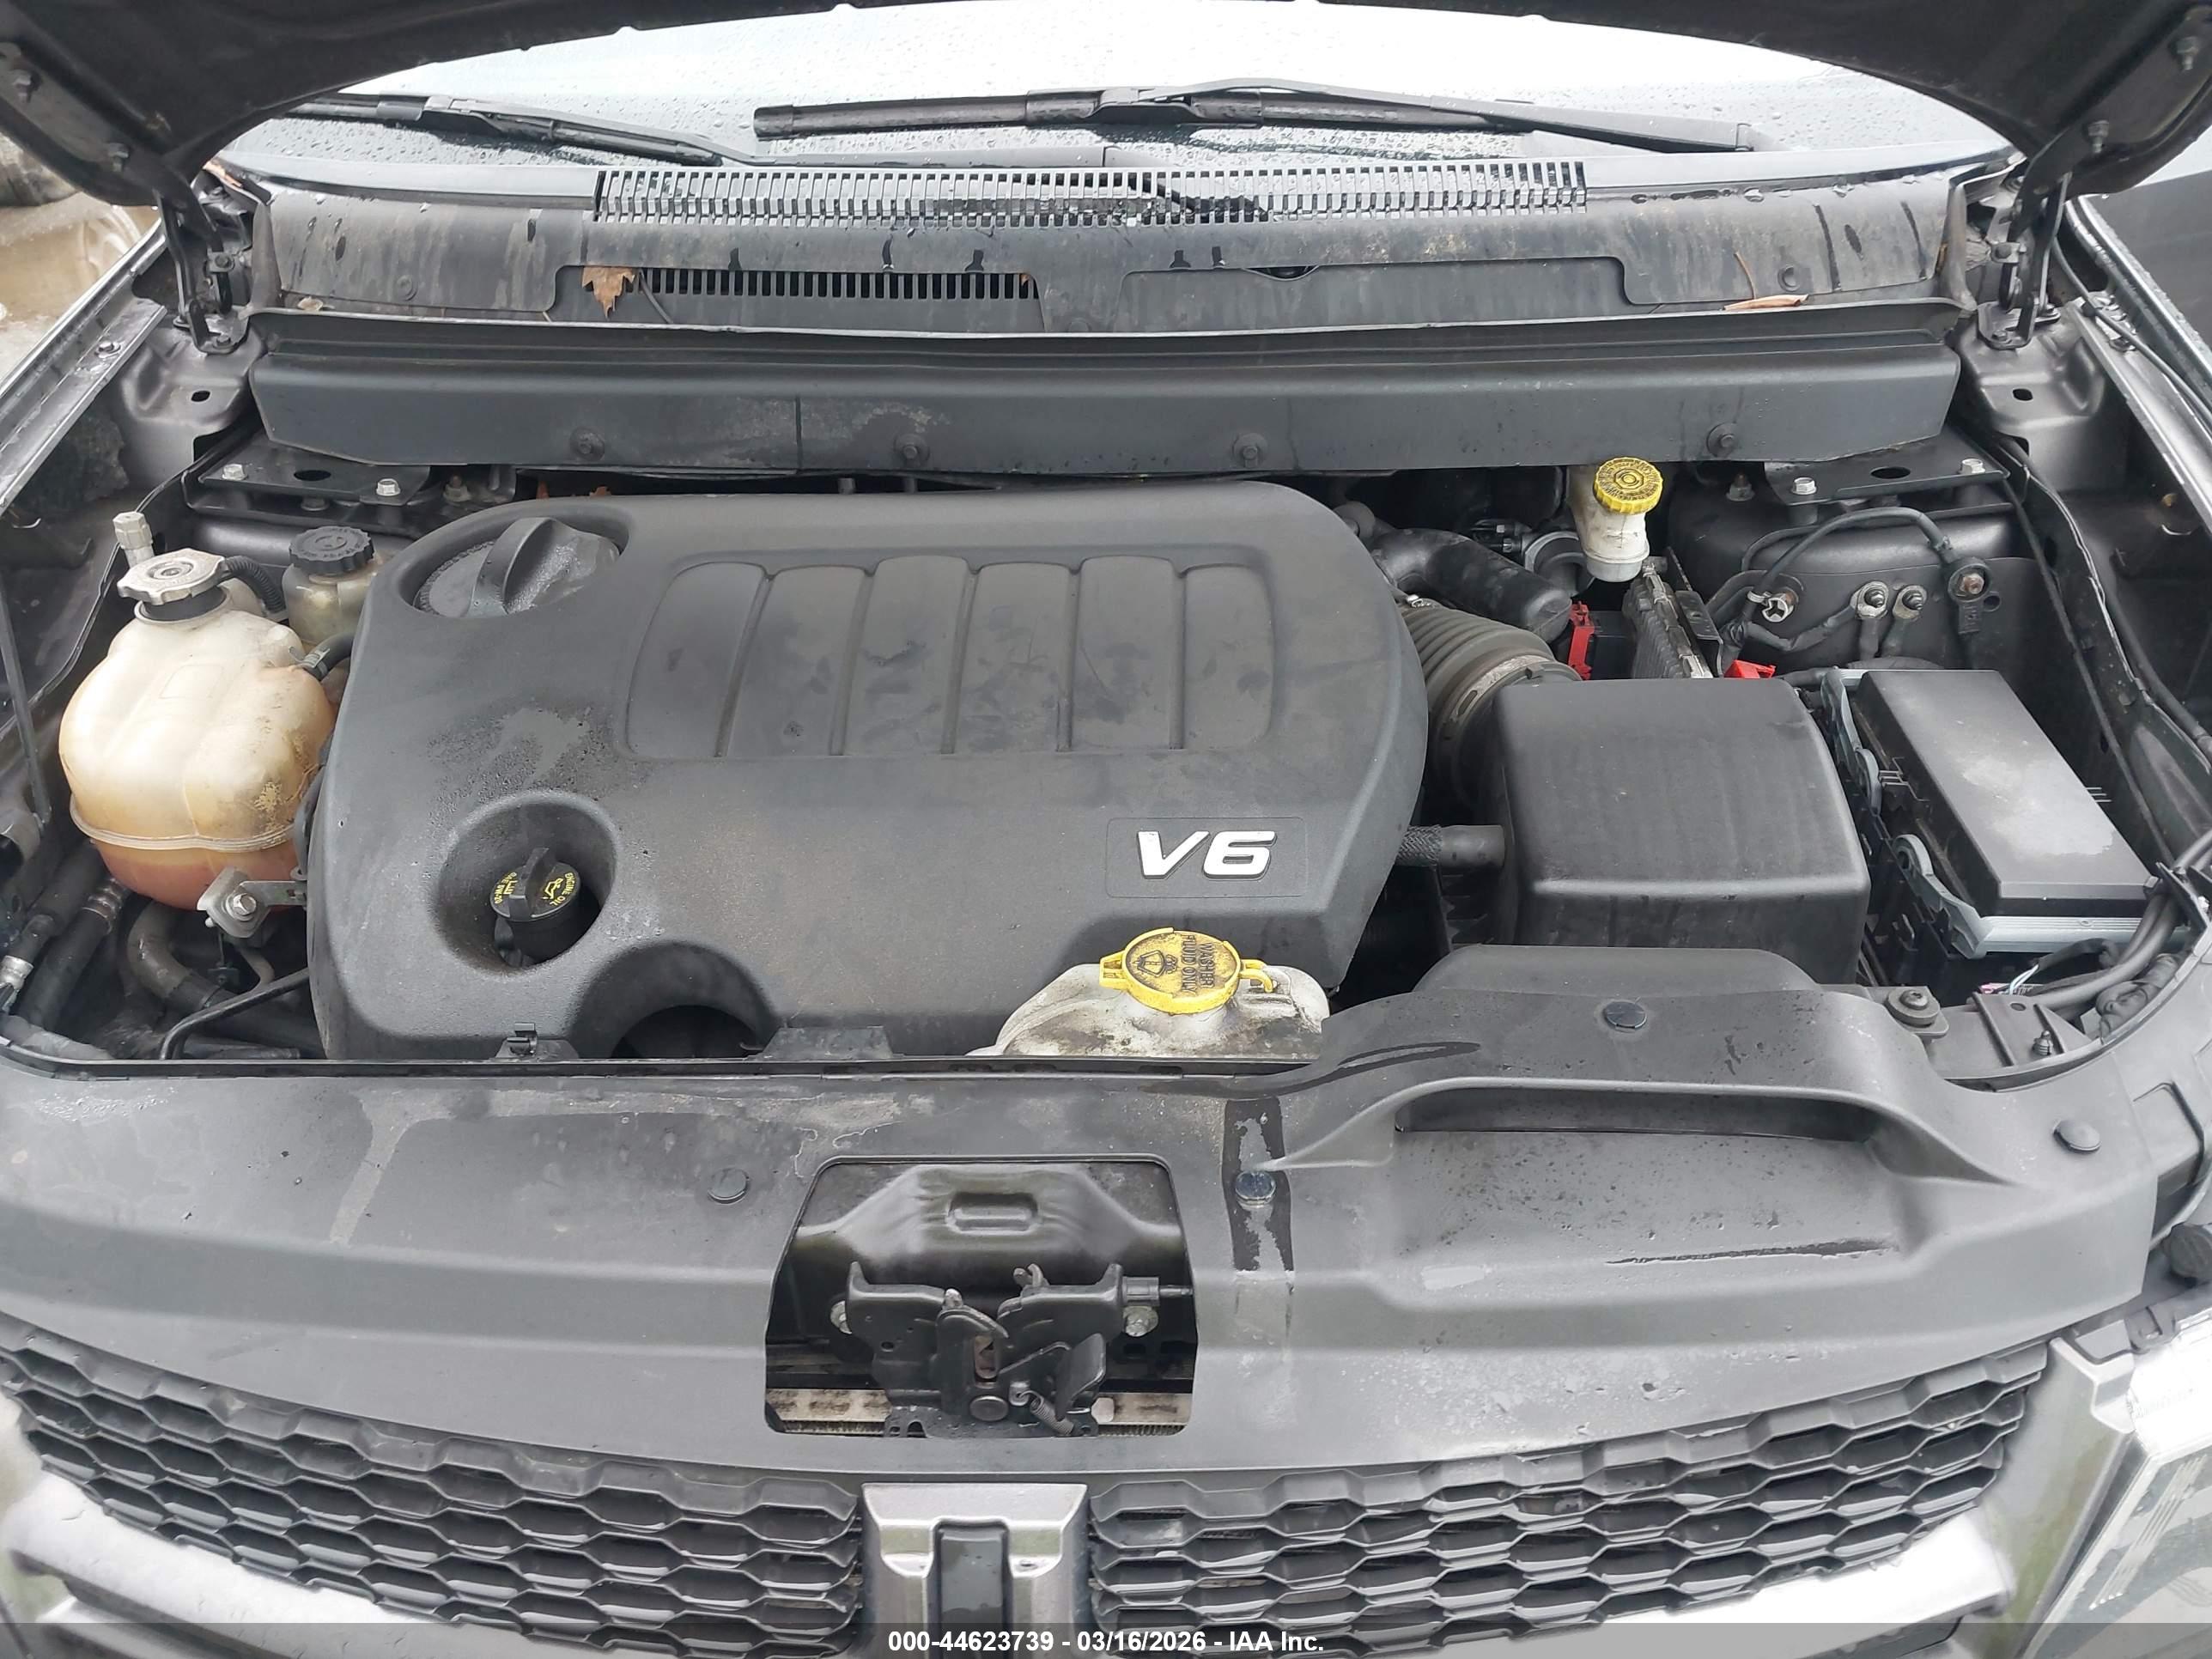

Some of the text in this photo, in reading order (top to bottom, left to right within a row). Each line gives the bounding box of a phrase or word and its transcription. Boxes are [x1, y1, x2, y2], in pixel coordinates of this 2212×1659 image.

[1136, 830, 1278, 880] V6
[550, 872, 575, 906] ENGINE OIL
[1181, 933, 1197, 995] FLUID ONLY
[1200, 942, 1215, 988] WASHER
